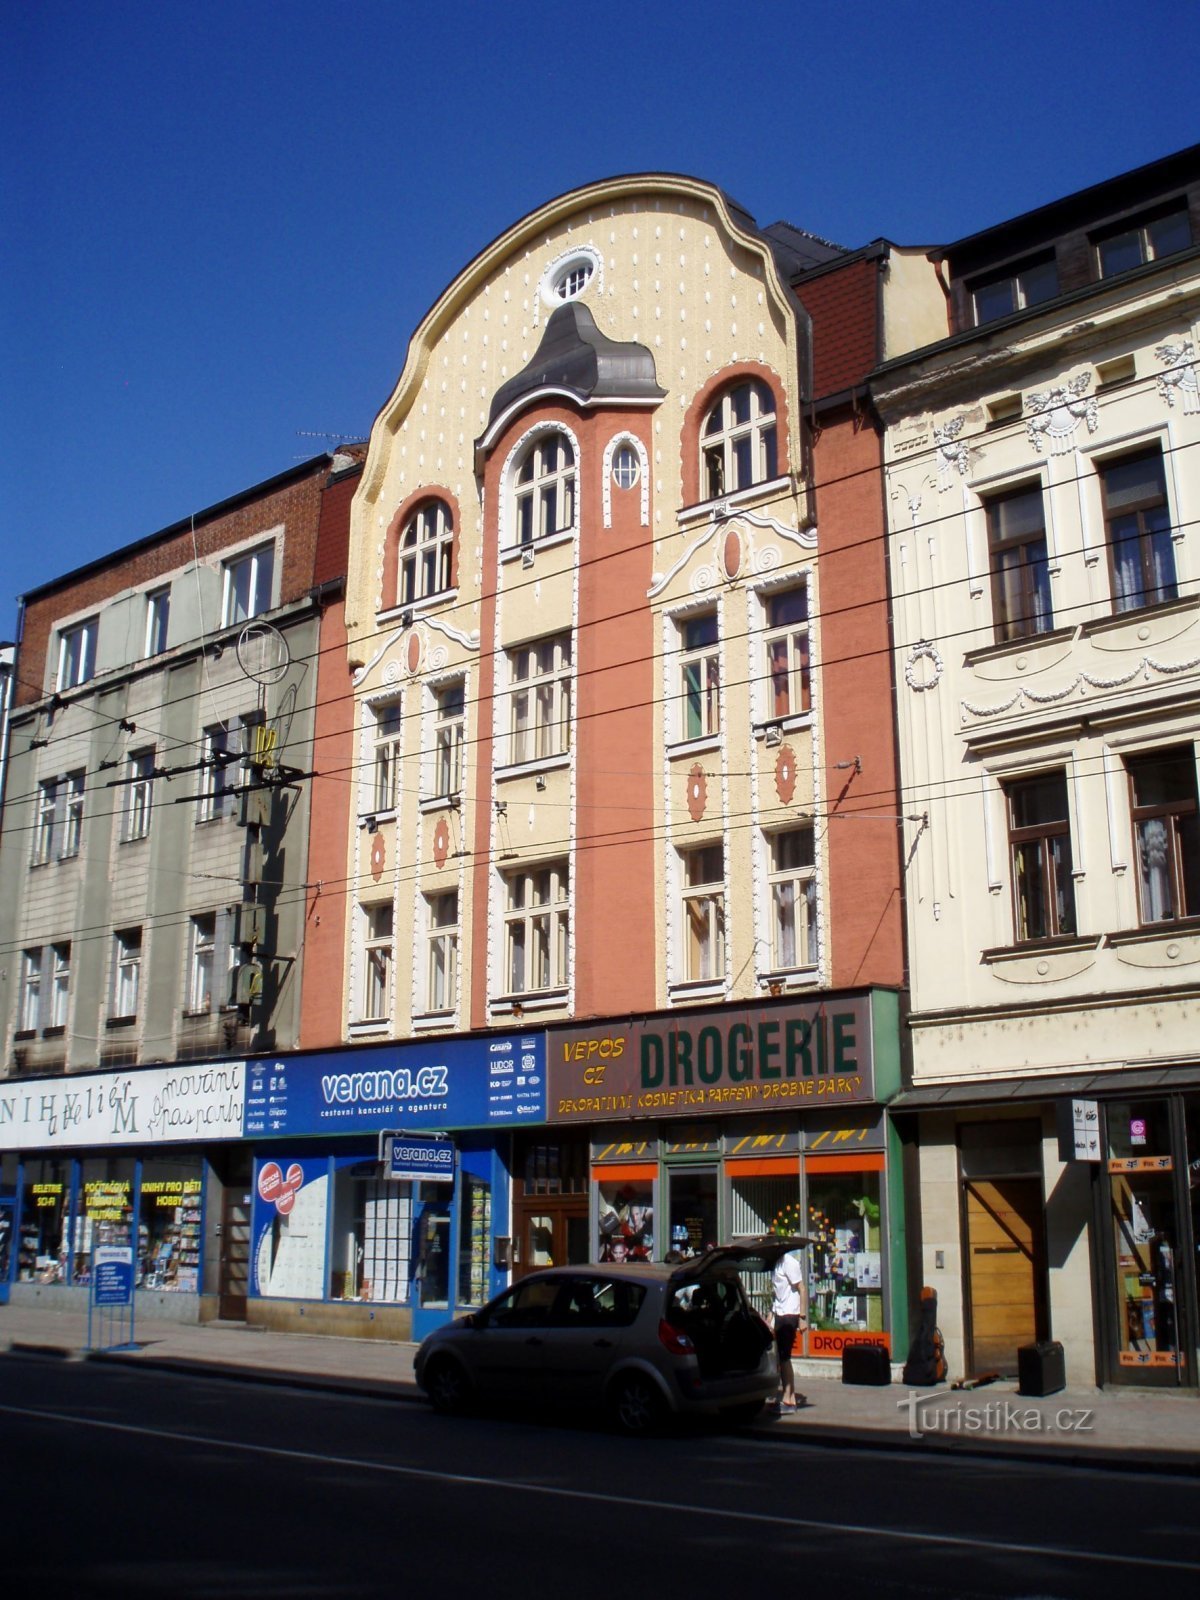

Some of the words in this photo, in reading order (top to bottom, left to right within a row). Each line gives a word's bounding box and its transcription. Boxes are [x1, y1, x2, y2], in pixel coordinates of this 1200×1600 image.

[563, 1037, 625, 1062] VEPOS
[640, 1012, 858, 1089] DROGERIE
[490, 1060, 514, 1070] LUDOR
[583, 1066, 606, 1084] CZ
[321, 1065, 449, 1104] verana.cz
[320, 1107, 354, 1117] cestovní
[358, 1105, 394, 1115] kancelář
[408, 1102, 448, 1113] agentura
[393, 1147, 452, 1163] verana.cz
[32, 1183, 62, 1194] BELETRIE
[140, 1182, 165, 1193] KNIHY
[166, 1181, 182, 1192] PRO
[183, 1178, 202, 1193] DĚTI
[37, 1196, 56, 1207] SCI-FI
[156, 1196, 183, 1206] HOBBY
